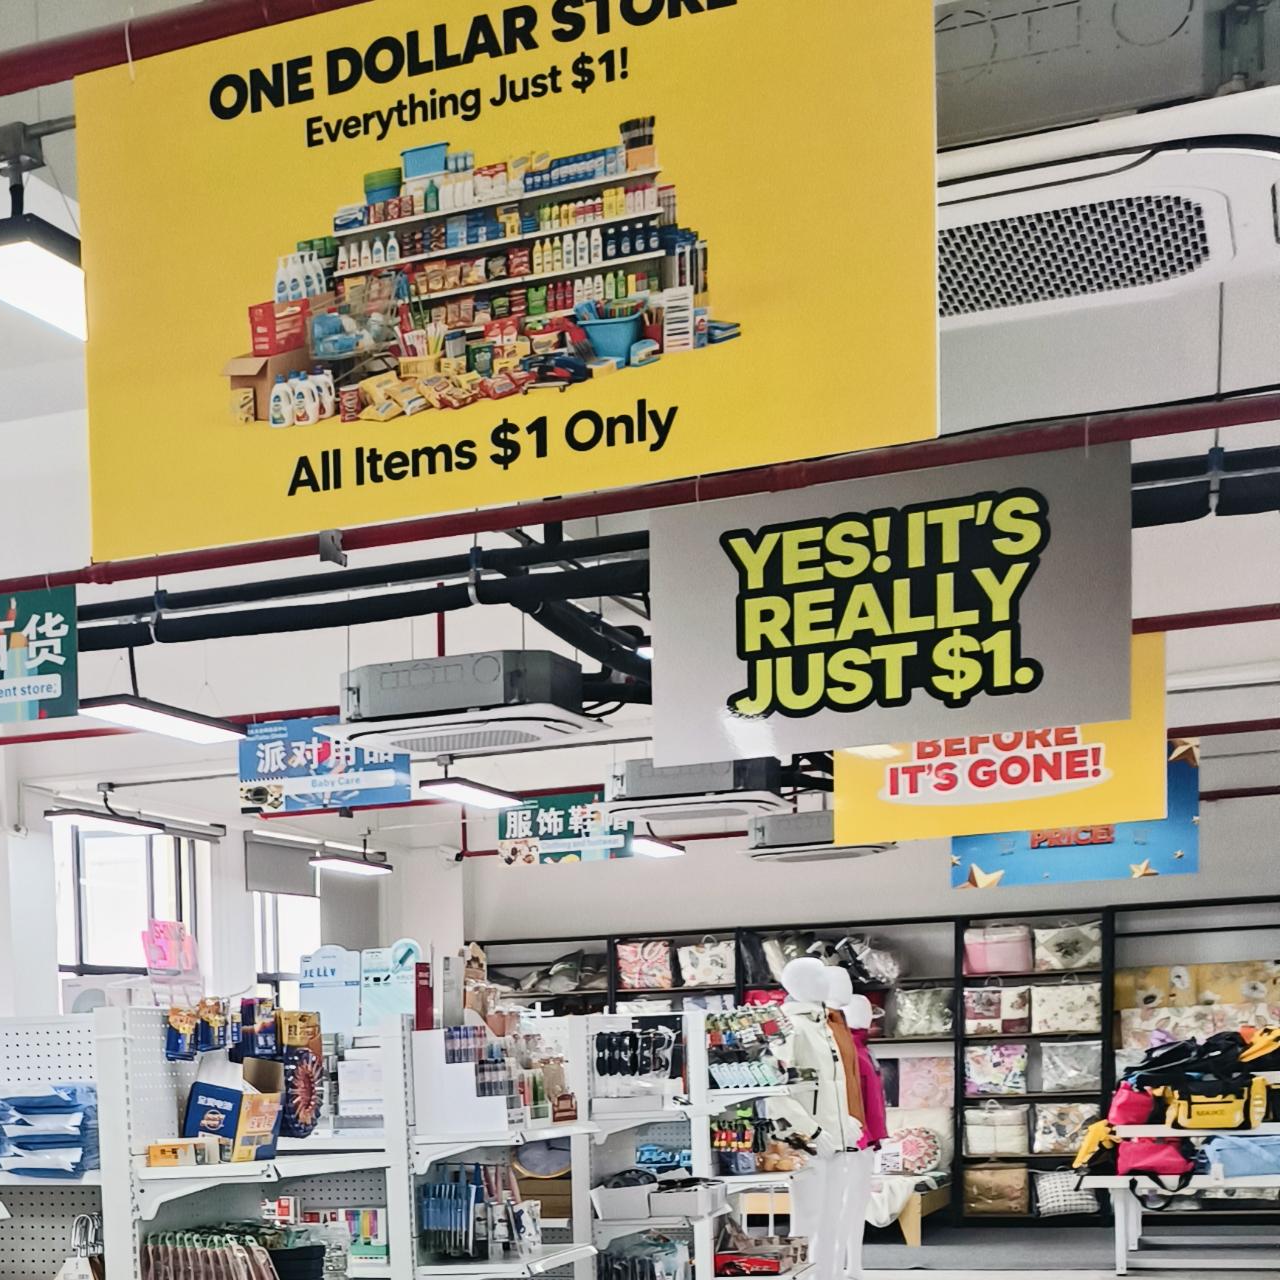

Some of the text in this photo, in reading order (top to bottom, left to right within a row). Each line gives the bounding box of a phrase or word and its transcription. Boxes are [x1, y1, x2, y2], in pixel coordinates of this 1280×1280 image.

[209, 55, 314, 120] ONE
[327, 4, 539, 95] DOLLAR
[307, 46, 629, 147] Everything Just $1!
[287, 399, 678, 496] All Items $1 Only
[729, 497, 1042, 589] YES! IT'S
[744, 563, 1030, 652] REALLY
[736, 629, 1034, 716] JUST $1.
[312, 776, 361, 789] Baby Care
[888, 747, 1101, 796] IT'S GONE!
[916, 727, 1078, 760] BEFORE
